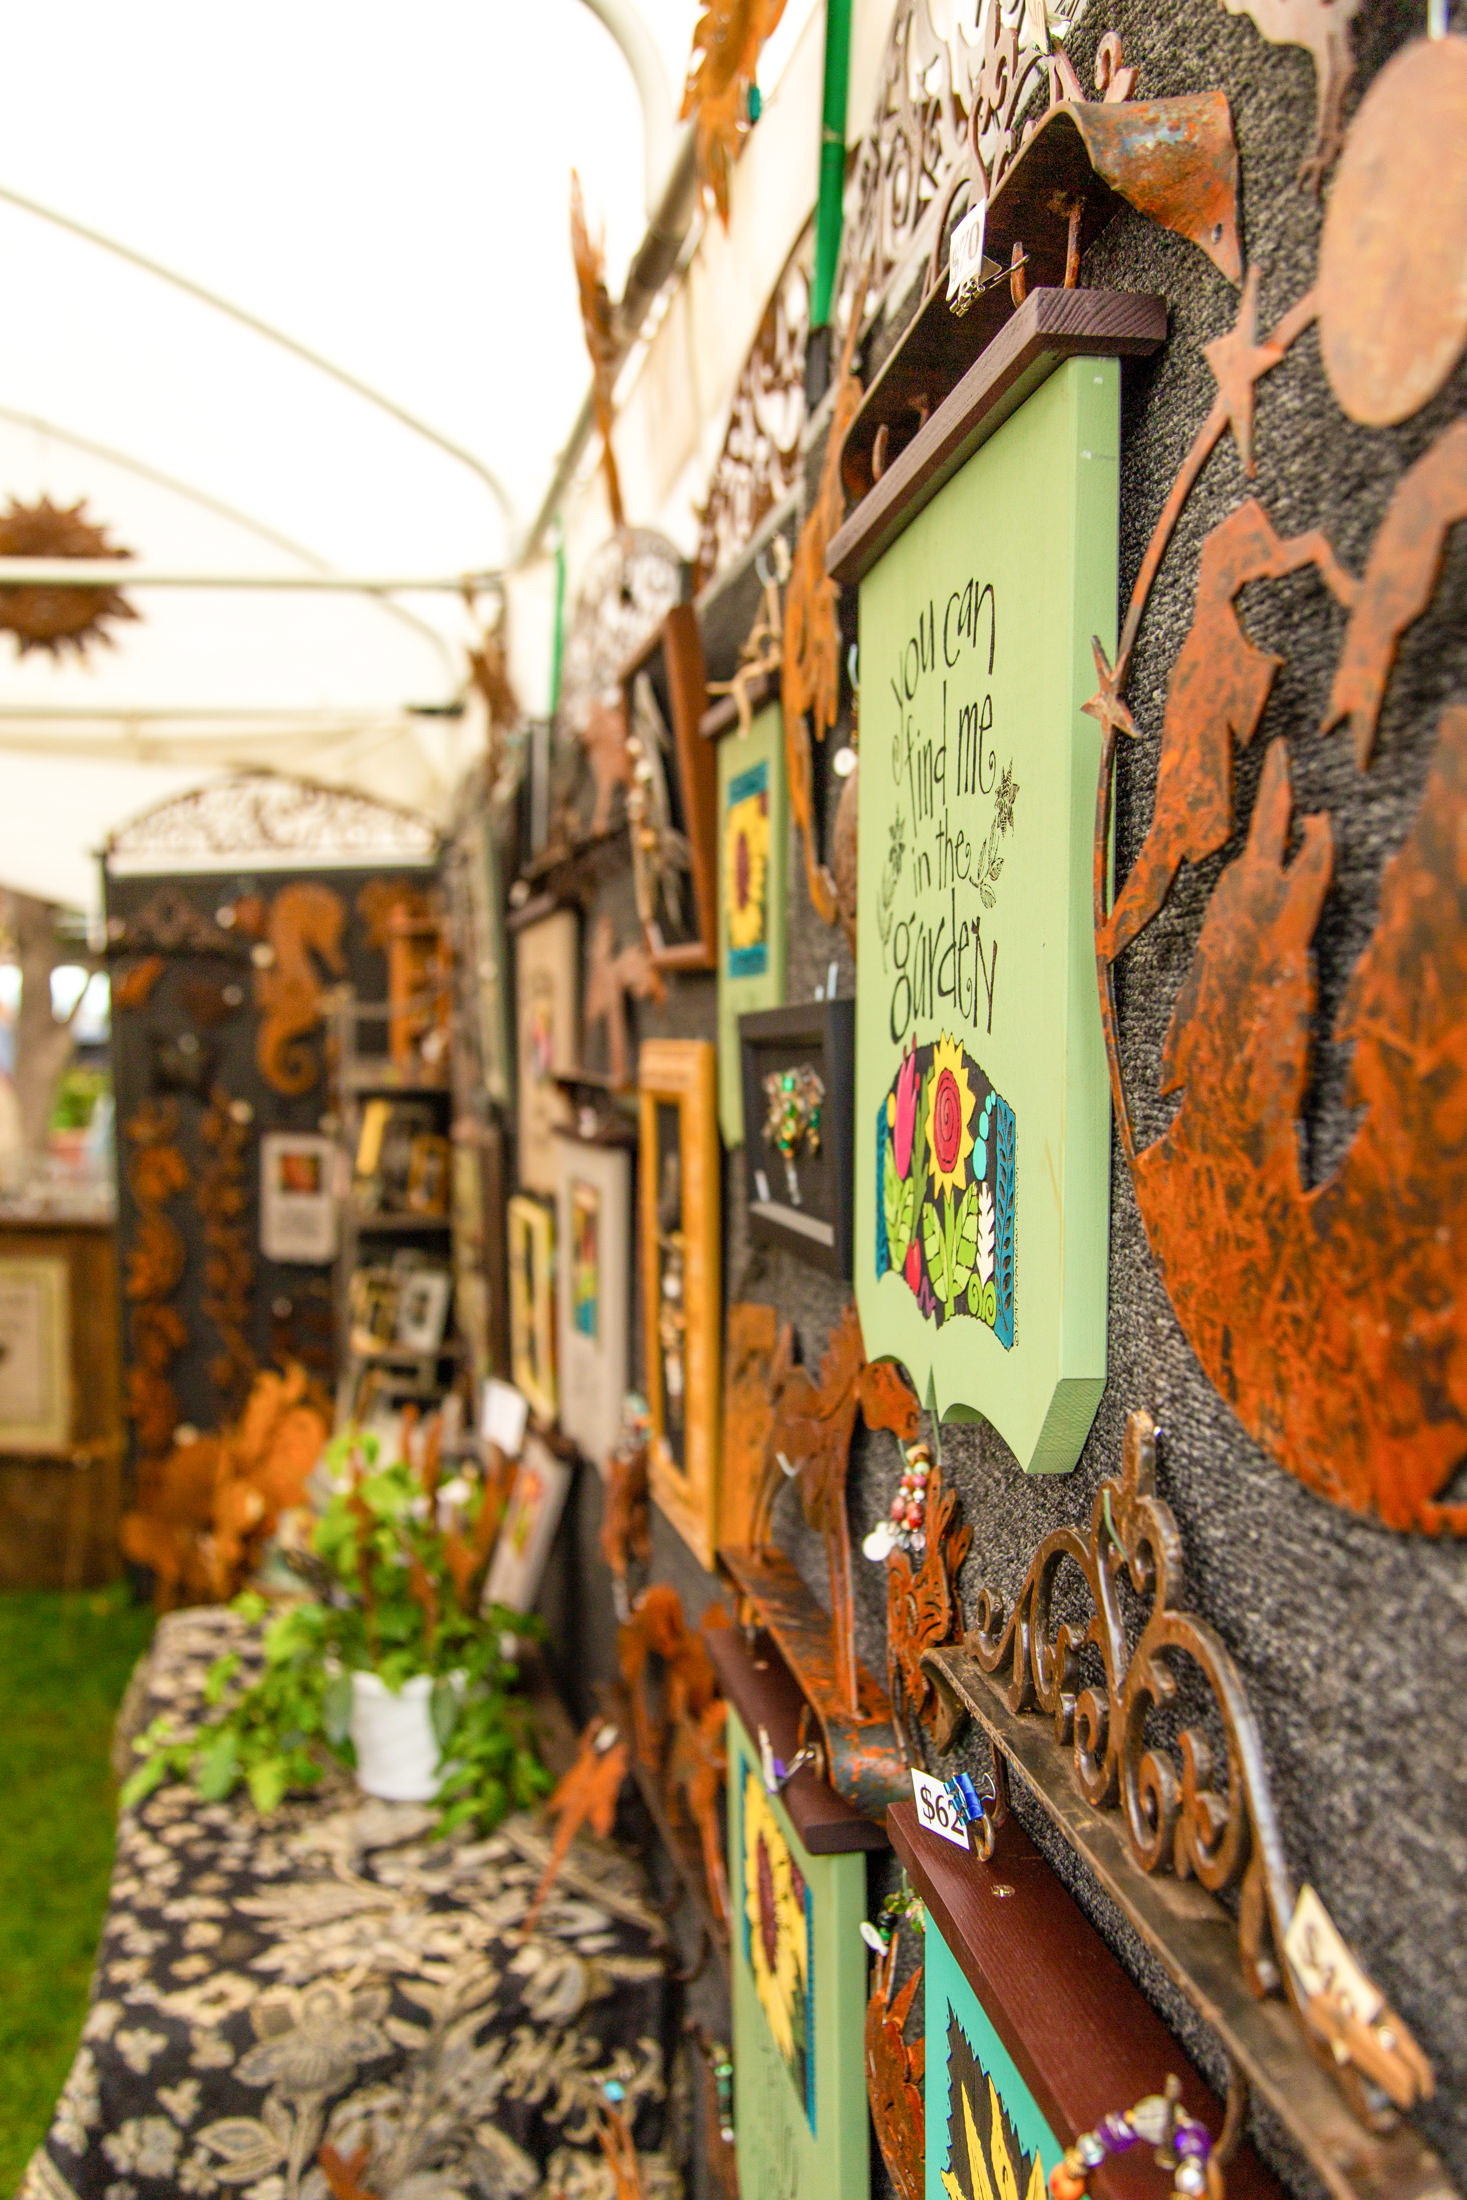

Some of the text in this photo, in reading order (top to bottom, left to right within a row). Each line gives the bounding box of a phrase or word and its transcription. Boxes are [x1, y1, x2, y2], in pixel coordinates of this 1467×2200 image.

[943, 577, 996, 676] can
[905, 679, 997, 839] find me
[911, 807, 972, 898] in the
